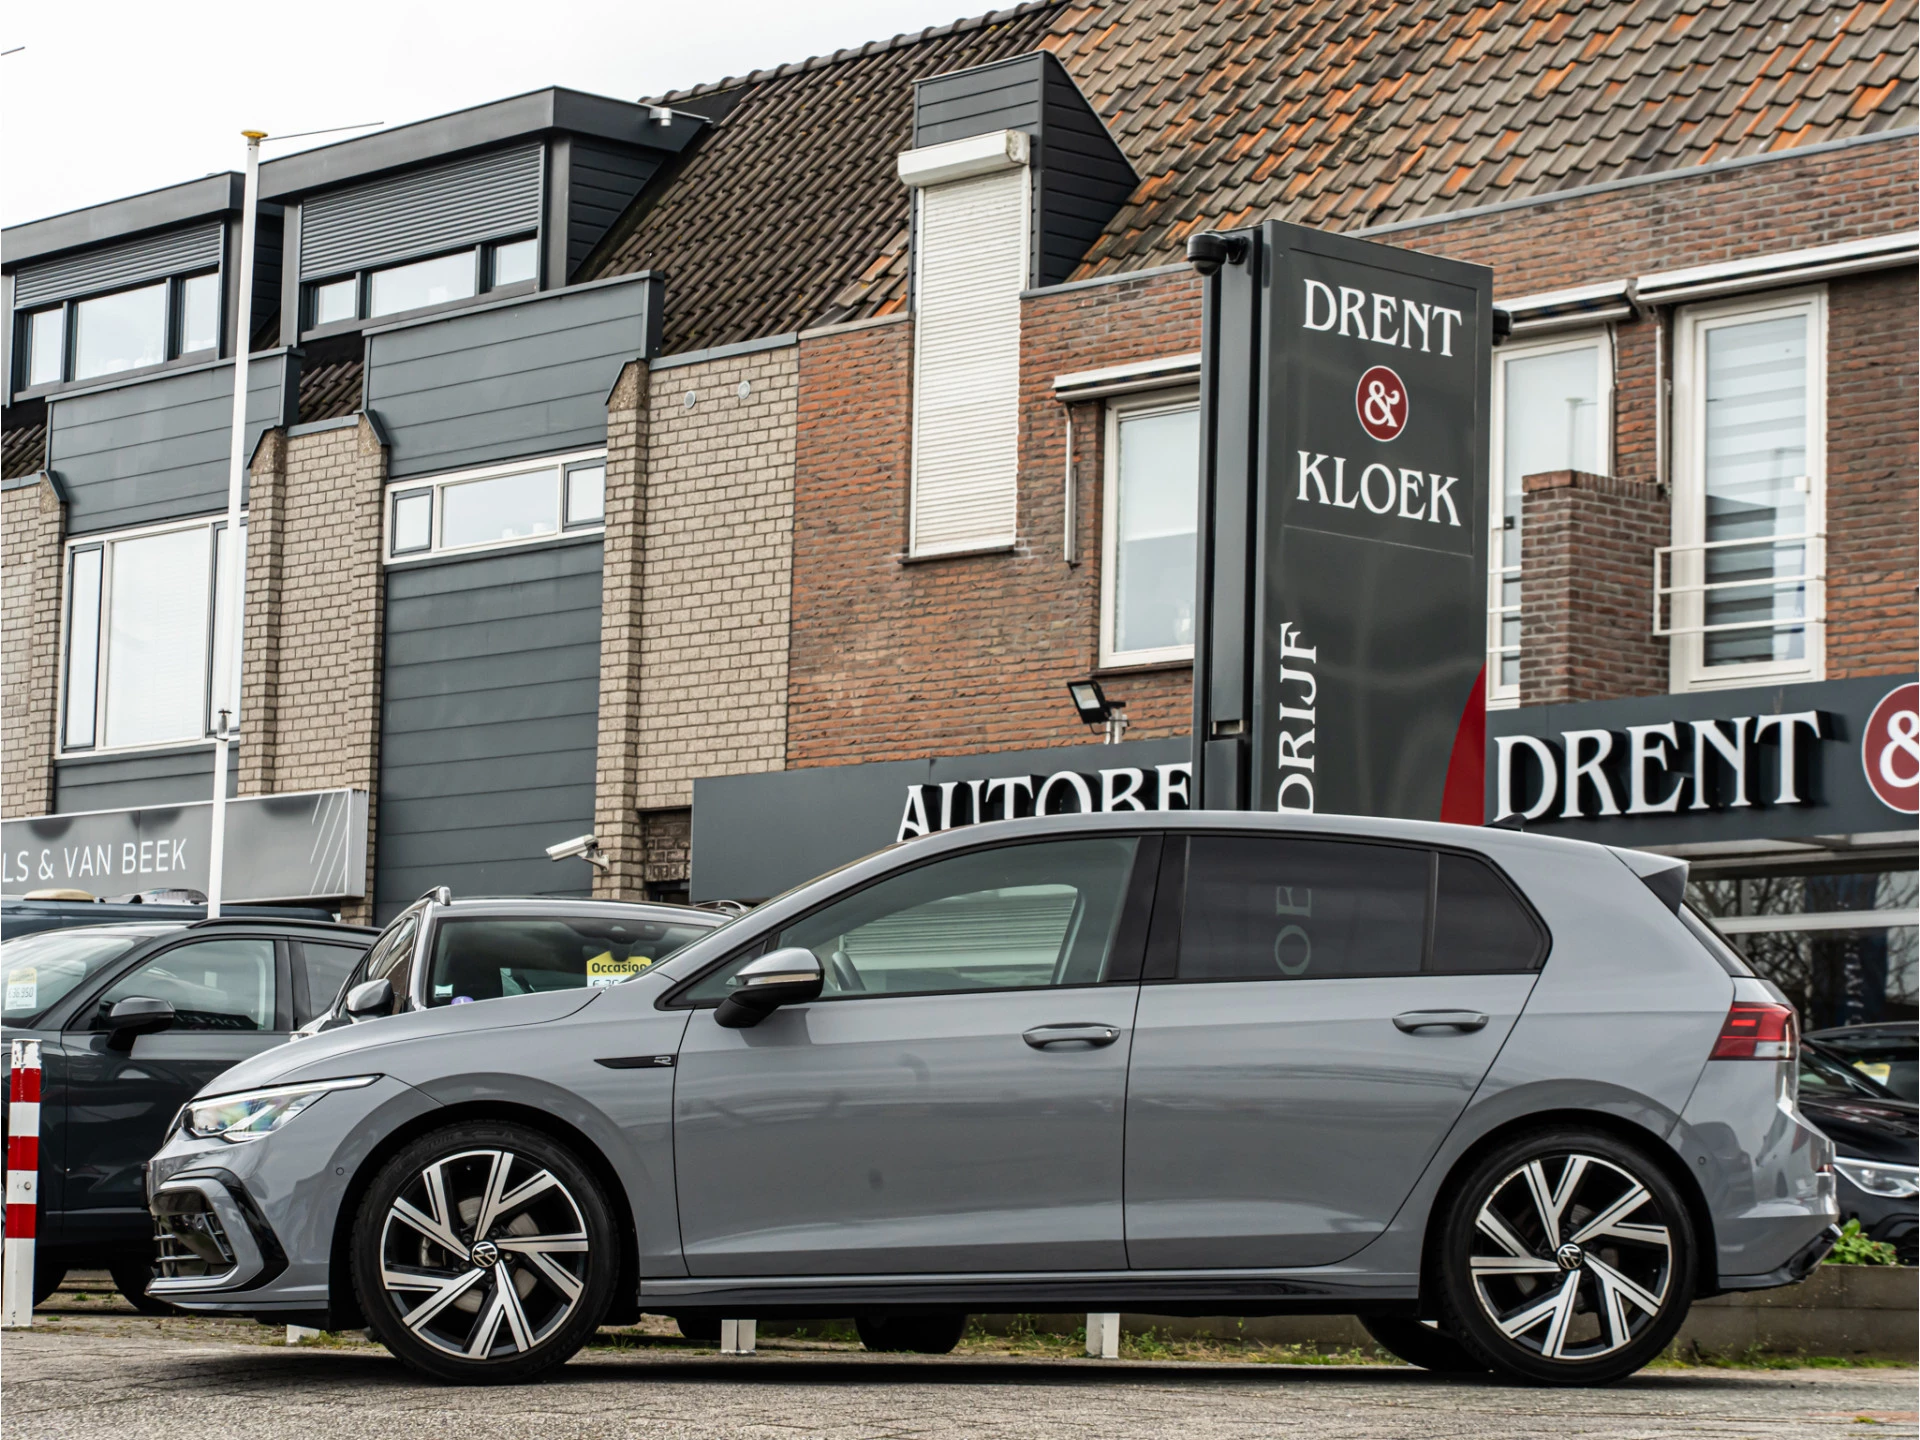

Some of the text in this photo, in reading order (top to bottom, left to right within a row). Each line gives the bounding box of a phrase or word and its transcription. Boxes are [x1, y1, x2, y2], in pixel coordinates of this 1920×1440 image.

[1302, 278, 1462, 357] DRENT
[1364, 380, 1400, 427] &
[1296, 450, 1461, 527] KLOEK
[1493, 710, 1821, 822] DRENT
[38, 849, 54, 881] &
[64, 844, 111, 878] VAN
[121, 838, 187, 874] BEEK
